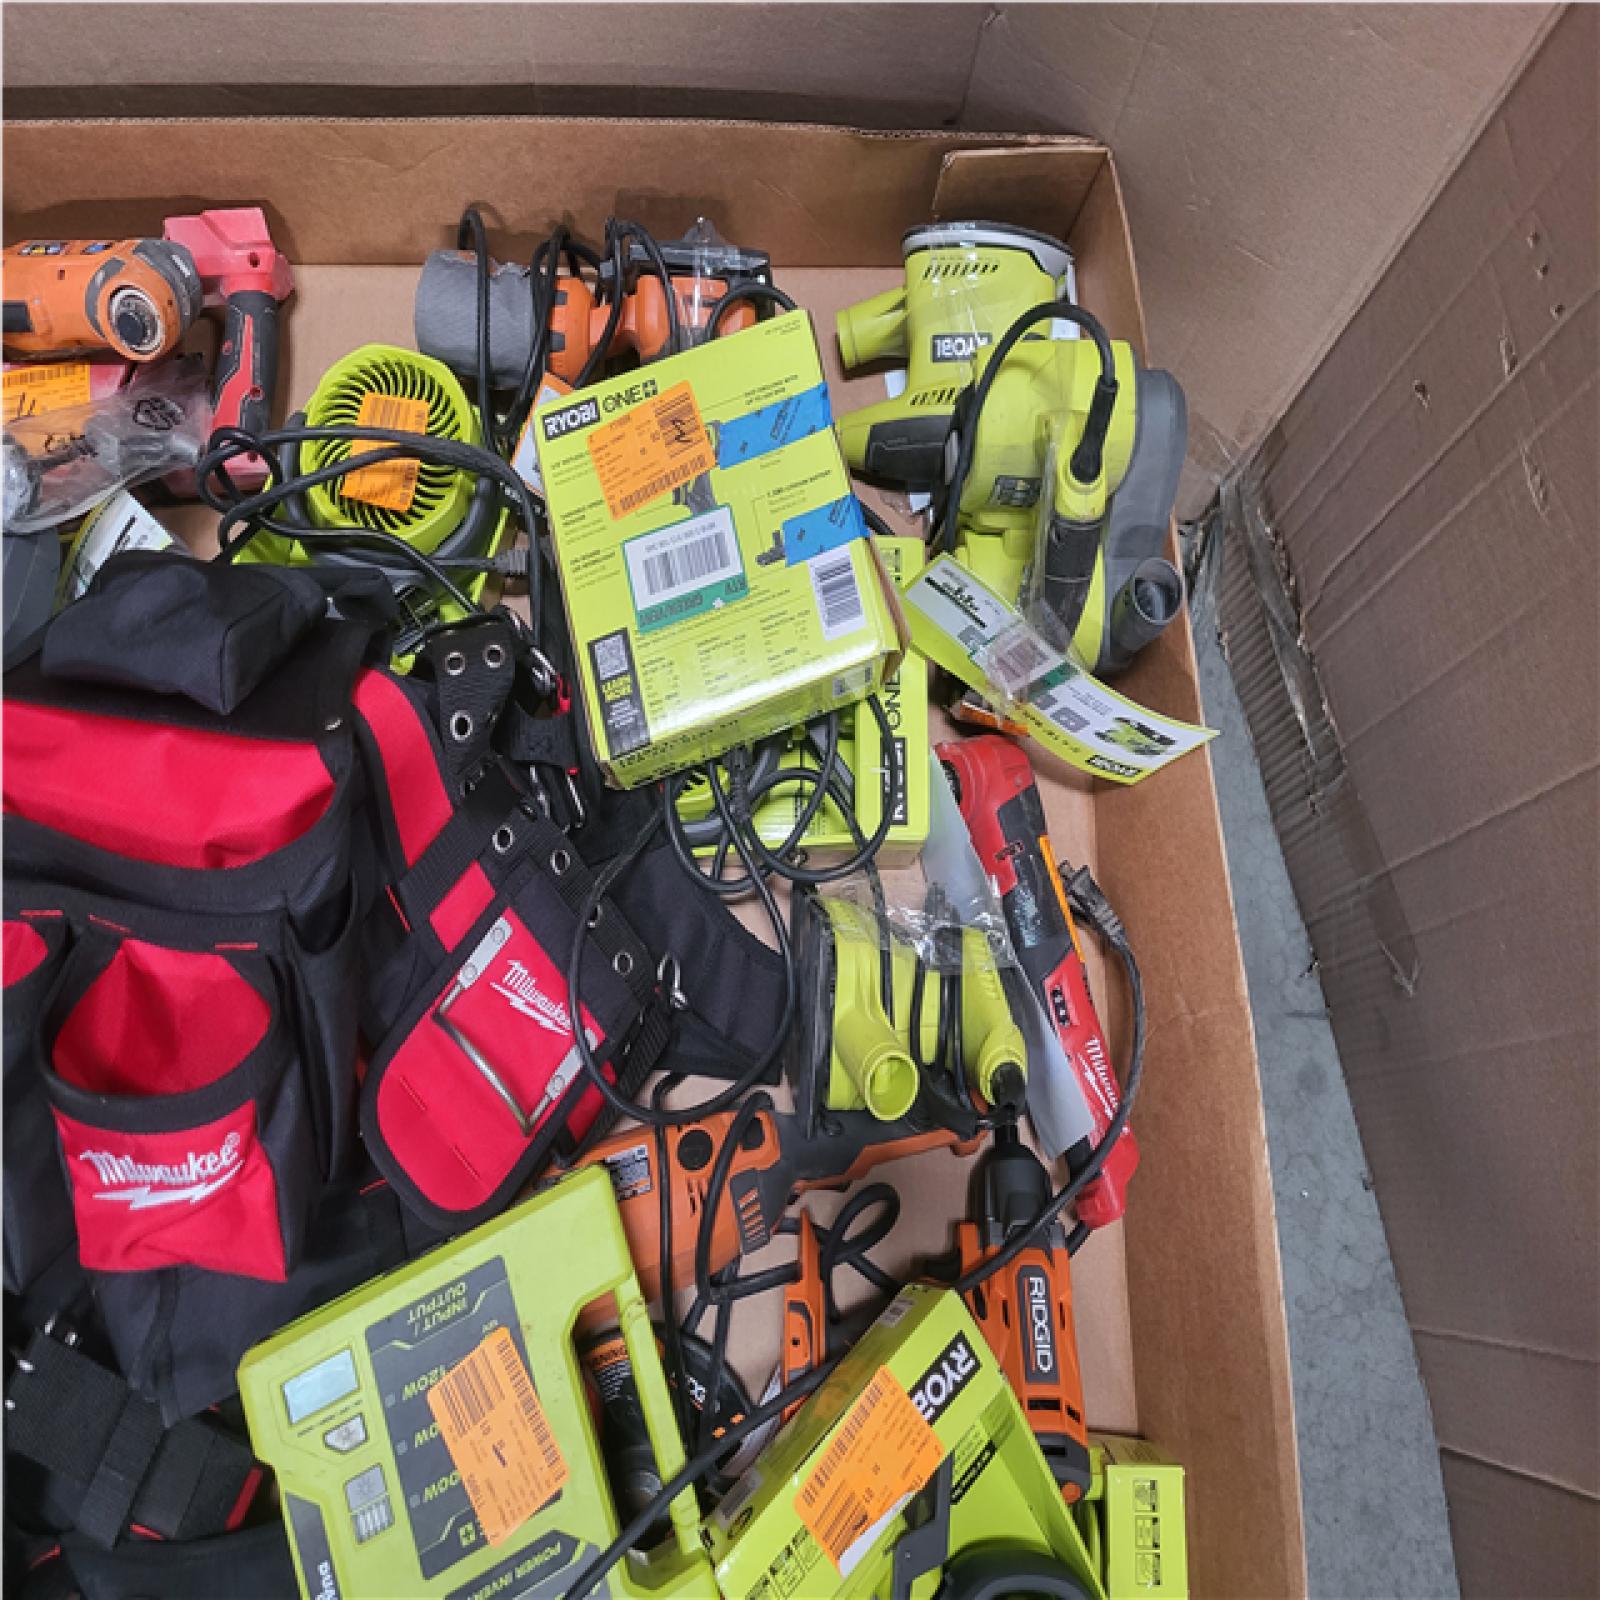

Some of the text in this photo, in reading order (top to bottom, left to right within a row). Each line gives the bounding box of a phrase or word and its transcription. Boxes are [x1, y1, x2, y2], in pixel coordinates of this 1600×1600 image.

[545, 403, 597, 436] RYOBI
[407, 1282, 466, 1325] OUTPUT
[1028, 1276, 1056, 1373] RIDGID
[911, 1341, 976, 1421] RYOB
[514, 1540, 561, 1578] POWER
